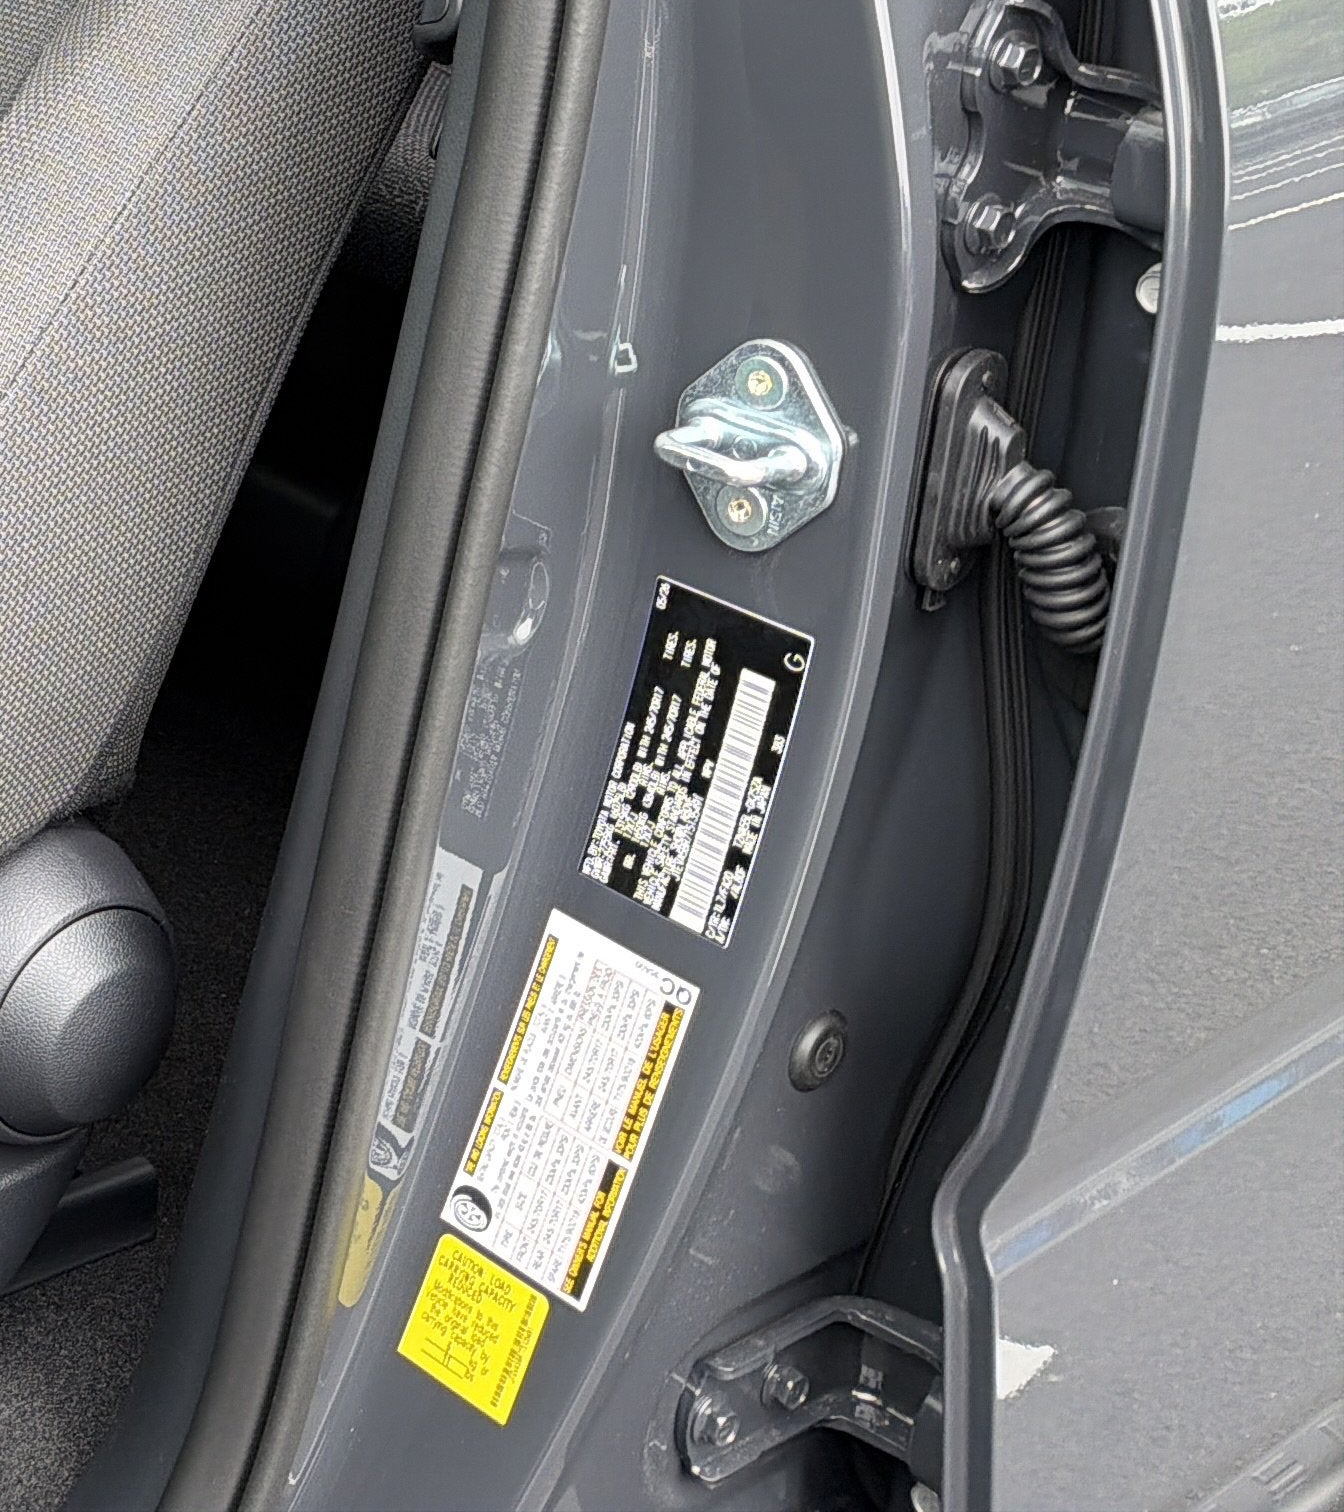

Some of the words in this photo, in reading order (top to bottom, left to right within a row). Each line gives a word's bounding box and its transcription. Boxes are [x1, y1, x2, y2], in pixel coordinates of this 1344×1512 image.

[701, 638, 717, 666] MOTOR
[782, 649, 806, 674] G
[709, 661, 721, 677] OF
[689, 667, 709, 706] FEDERAL
[703, 676, 718, 700] DATE
[697, 701, 711, 719] THE
[676, 707, 699, 760] APPLICABLE
[694, 720, 706, 735] ON
[611, 720, 635, 779] CORPORATION
[636, 733, 651, 759] WITH
[653, 741, 668, 767] WITH
[684, 735, 701, 769] EFFECT
[671, 761, 684, 779] ALL
[654, 794, 674, 839] CONFORMS
[641, 838, 660, 878] VEHICLE
[654, 833, 672, 867] SAFETY
[633, 877, 648, 901] THIS
[642, 867, 661, 907] VEHICLE
[621, 1115, 633, 1130] LE
[627, 1074, 648, 1115] MANUEL
[641, 1059, 653, 1075] DE
[622, 1131, 638, 1160] POUR
[632, 1105, 648, 1132] PLUS
[642, 1089, 654, 1105] DE
[477, 1280, 516, 1314] CAPACITY
[489, 1274, 512, 1296] LOAD
